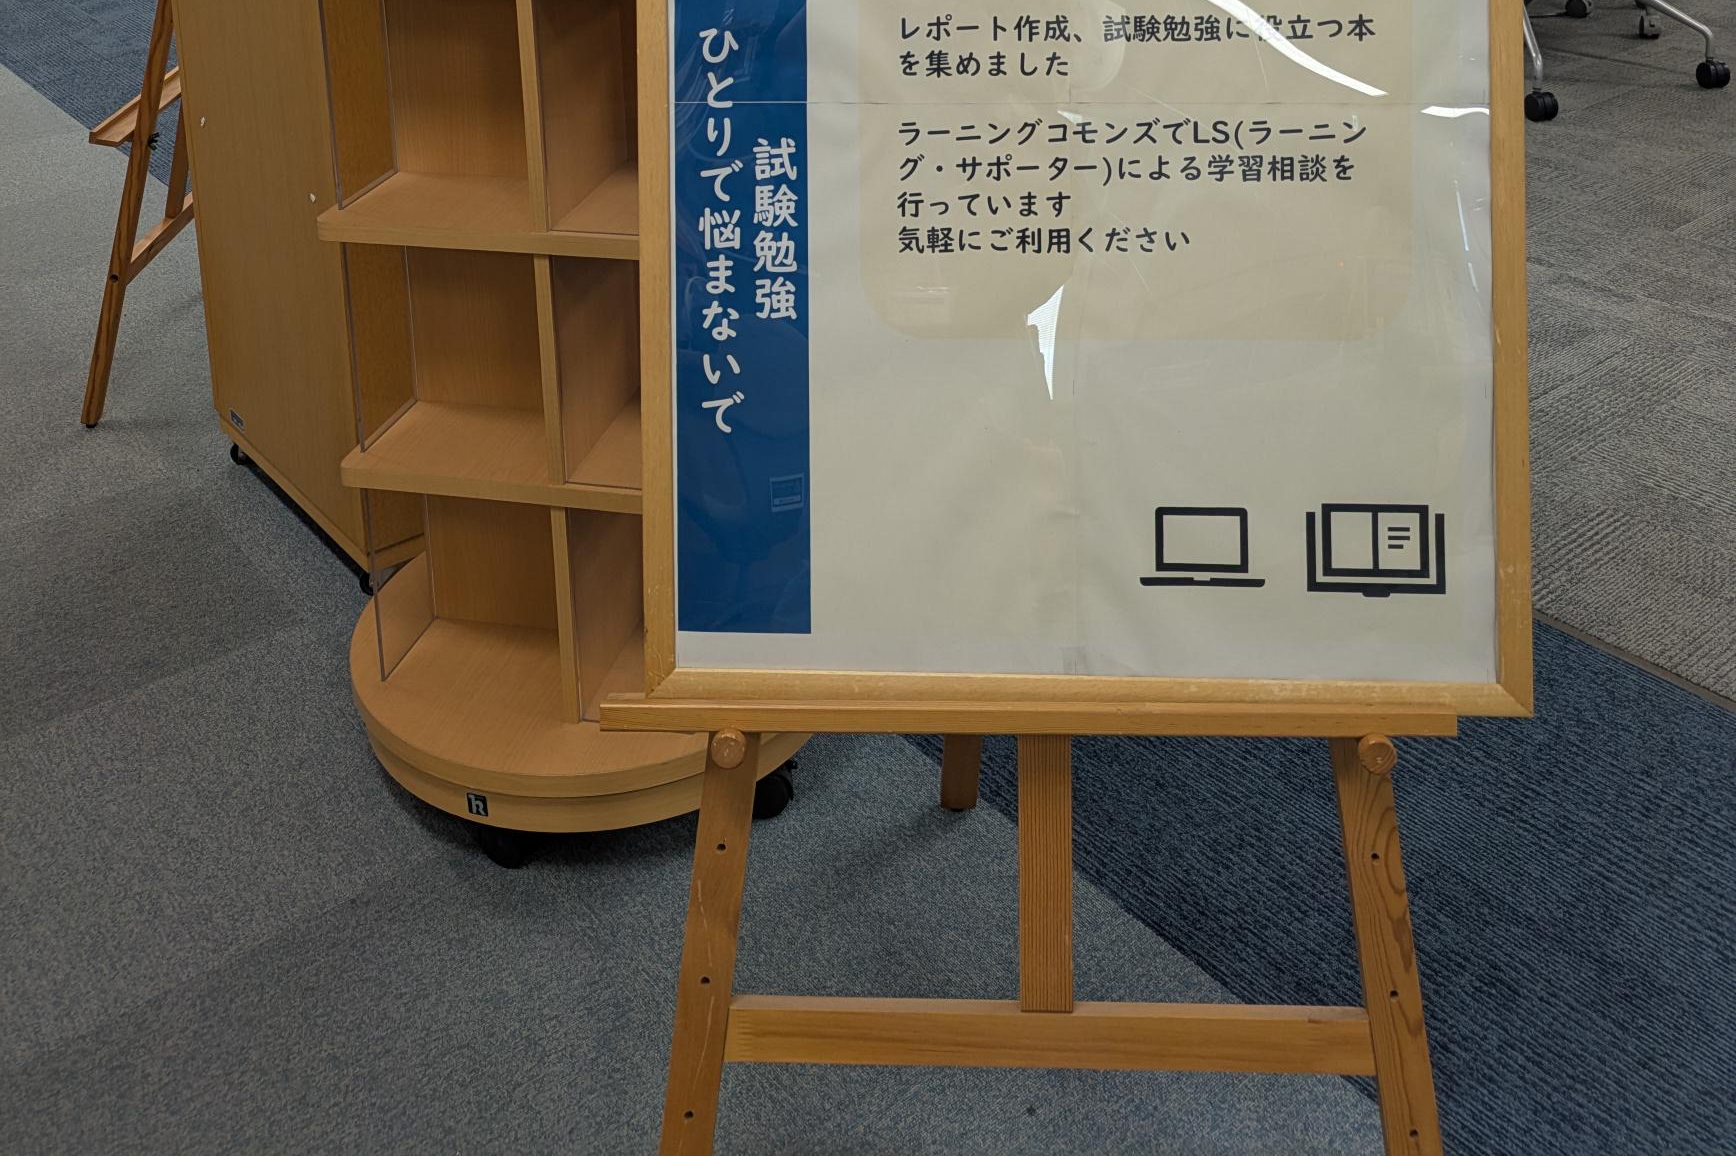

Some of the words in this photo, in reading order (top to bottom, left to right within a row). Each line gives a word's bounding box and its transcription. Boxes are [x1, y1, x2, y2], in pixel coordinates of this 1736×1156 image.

[899, 51, 1070, 79] を集めました
[898, 118, 1368, 150] ラーニングコモンズでLS(ラーニン
[898, 154, 1356, 187] グ・サポーター)による学習相談を
[897, 191, 1072, 220] 行っています
[698, 27, 745, 434] ひとりで悩まないで
[752, 137, 798, 320] 試験勉強
[898, 227, 1191, 255] 気軽にご利用ください
